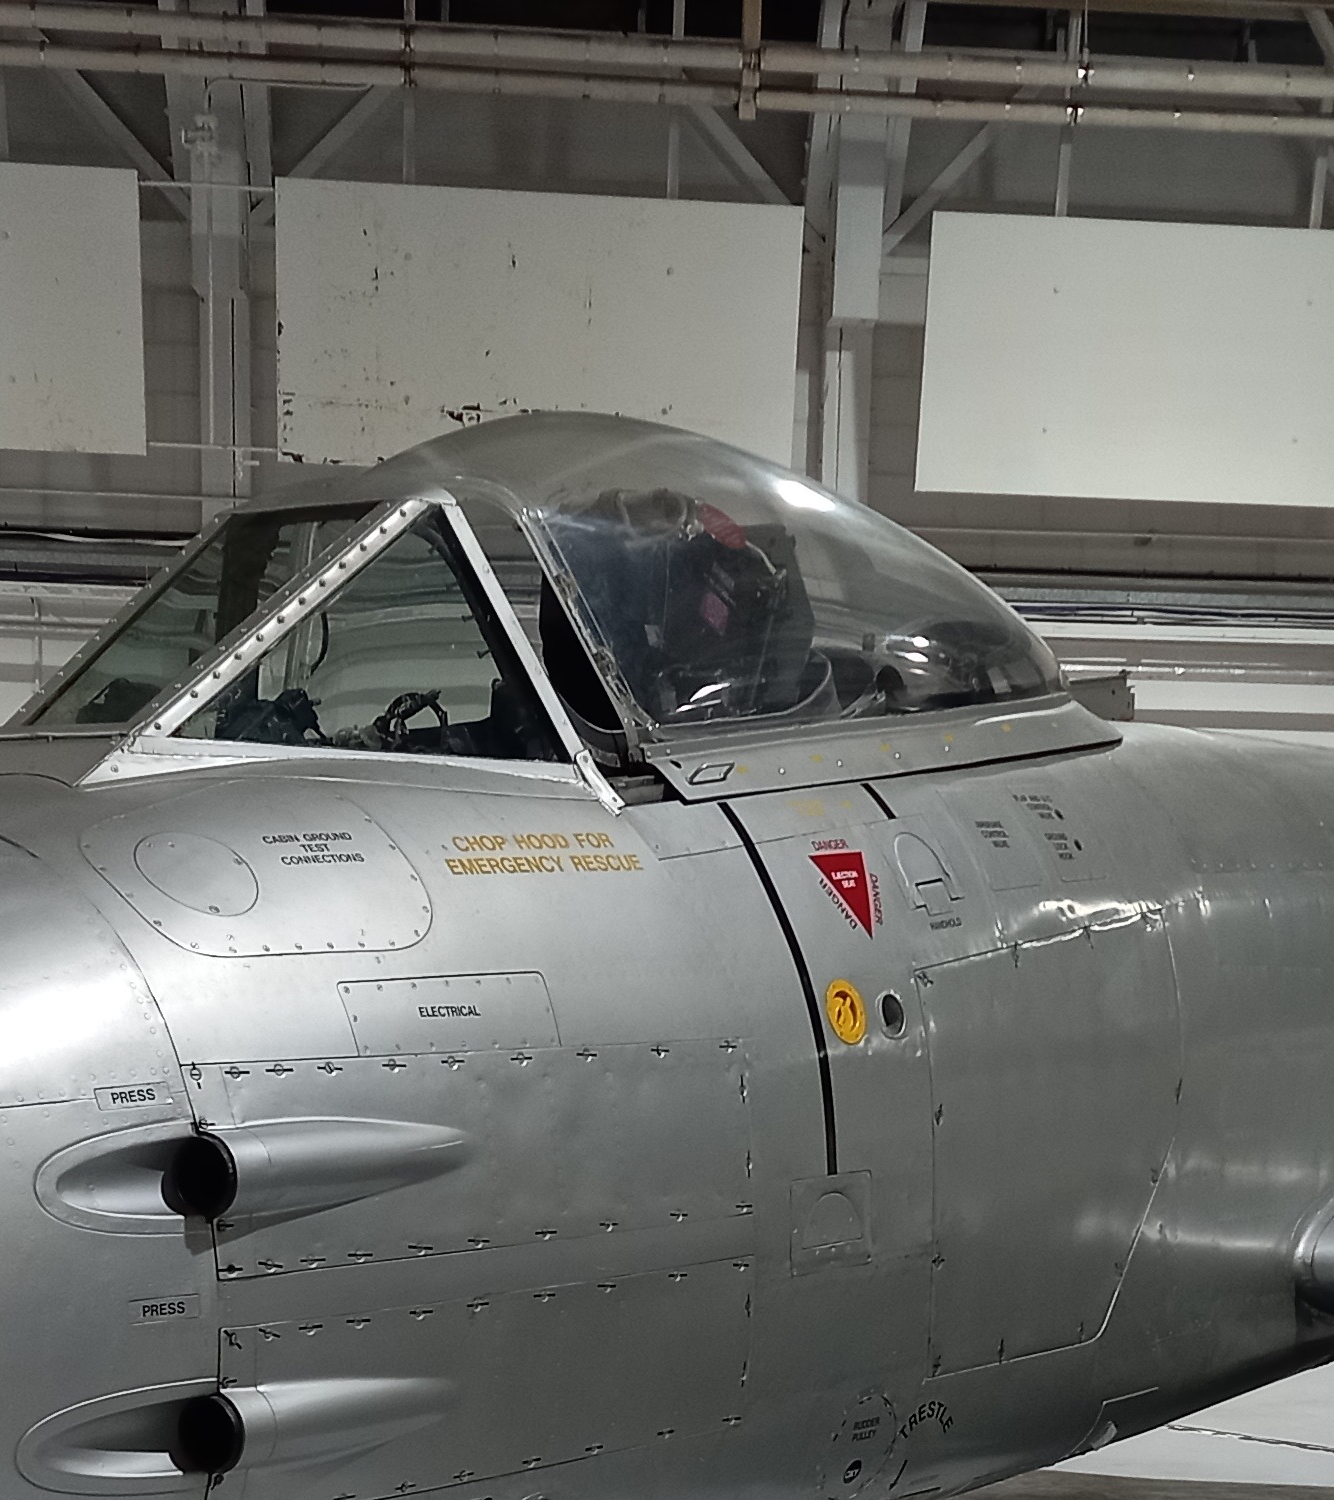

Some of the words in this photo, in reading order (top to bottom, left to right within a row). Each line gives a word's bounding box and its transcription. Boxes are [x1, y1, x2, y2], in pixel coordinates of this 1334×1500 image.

[262, 834, 301, 844] CABIN
[303, 832, 352, 842] GROUND
[455, 835, 508, 851] CHOP
[515, 834, 570, 850] HOOD
[574, 832, 613, 848] FOR
[810, 839, 849, 851] DANGER
[299, 843, 331, 853] TEST
[281, 853, 365, 865] CONNECTIONS
[446, 855, 563, 874] EMERGENCY
[571, 853, 642, 872] RESCUE
[819, 878, 858, 930] DANGER
[869, 872, 884, 926] DANGER
[419, 1005, 481, 1017] ELECTRICAL
[111, 1088, 156, 1104] PRESS
[142, 1302, 185, 1317] PRESS
[899, 1401, 954, 1438] TRESTLE
